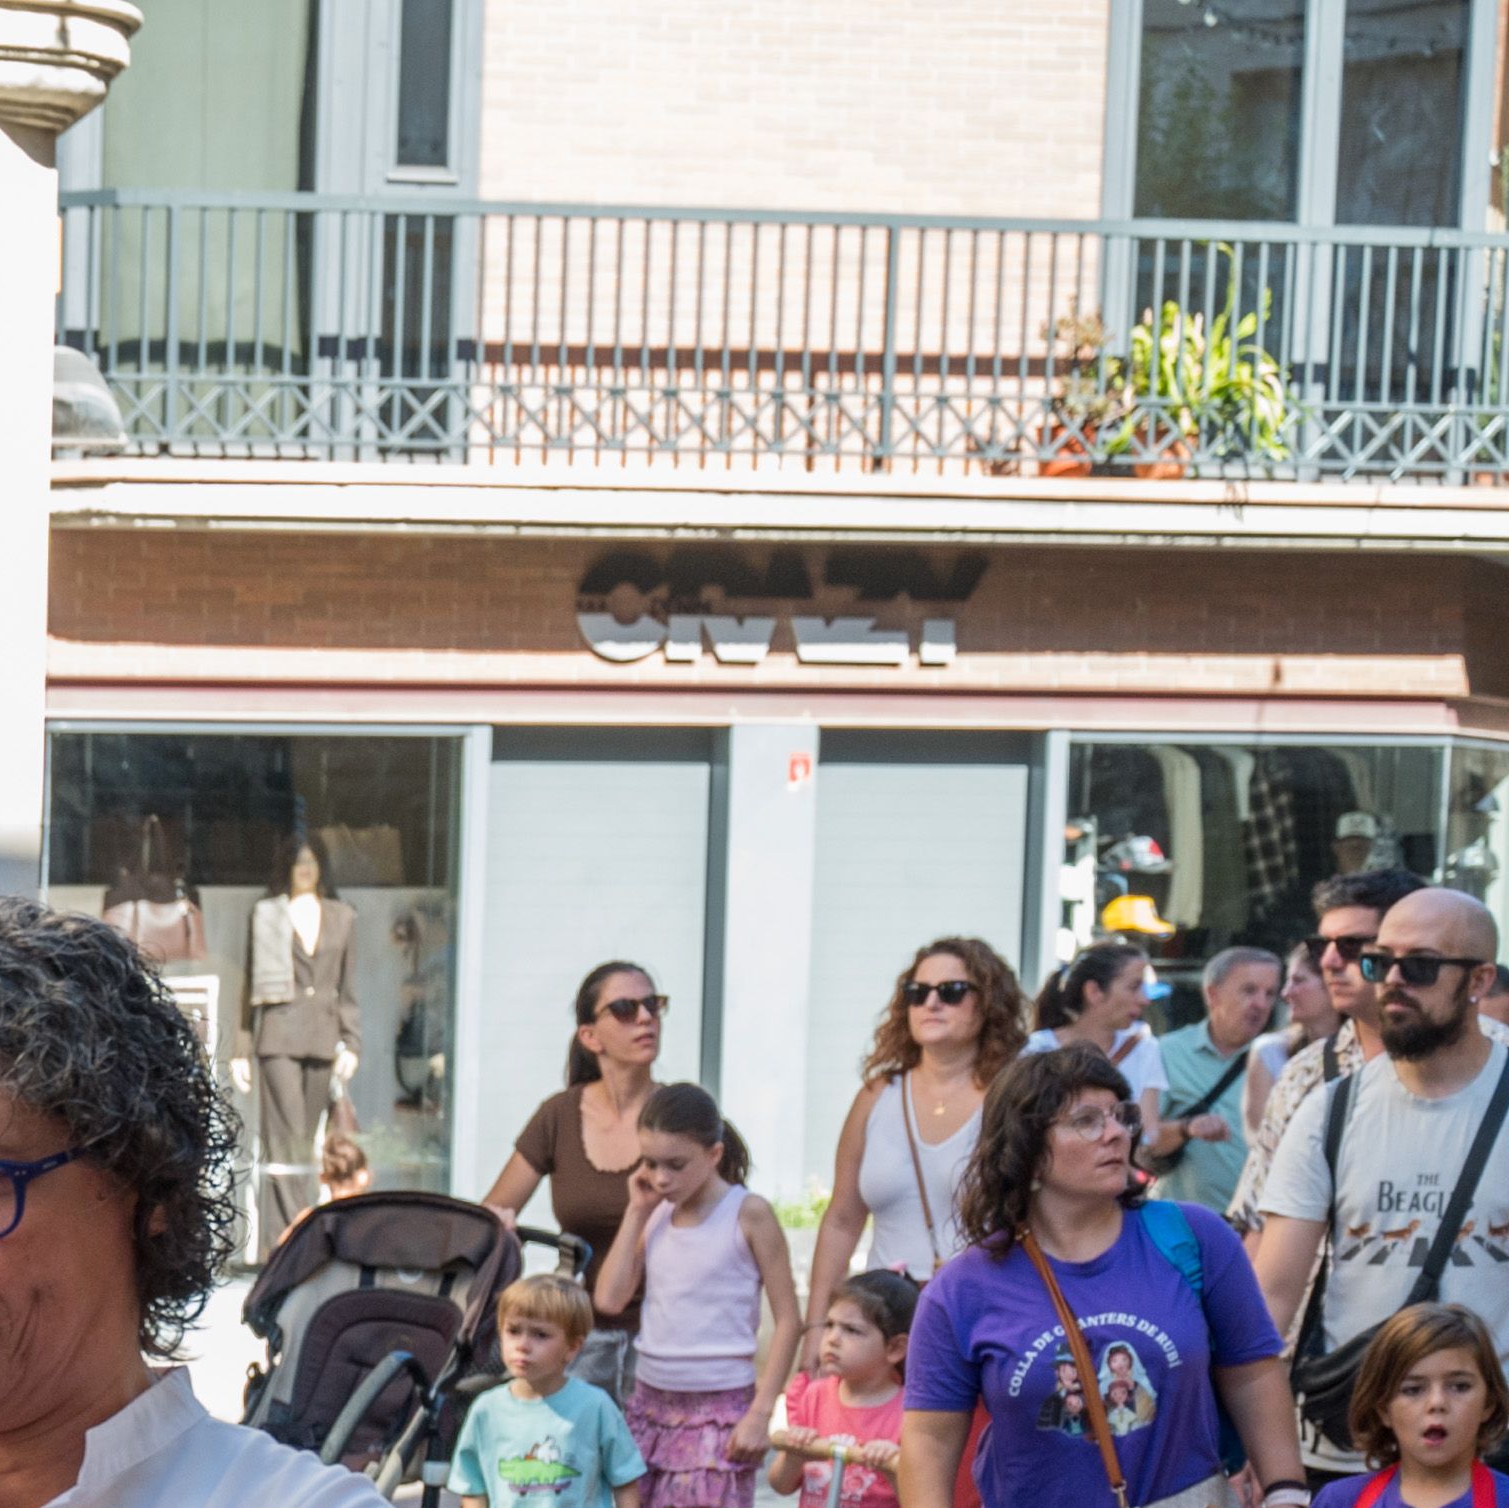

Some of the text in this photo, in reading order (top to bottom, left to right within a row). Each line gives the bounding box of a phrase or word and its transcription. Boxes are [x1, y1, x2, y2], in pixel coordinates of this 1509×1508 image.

[1416, 1173, 1440, 1186] THE
[1377, 1181, 1474, 1219] BEAGL
[1008, 1350, 1037, 1397] COLLA
[1034, 1331, 1054, 1351] DE
[1135, 1319, 1160, 1337] DE
